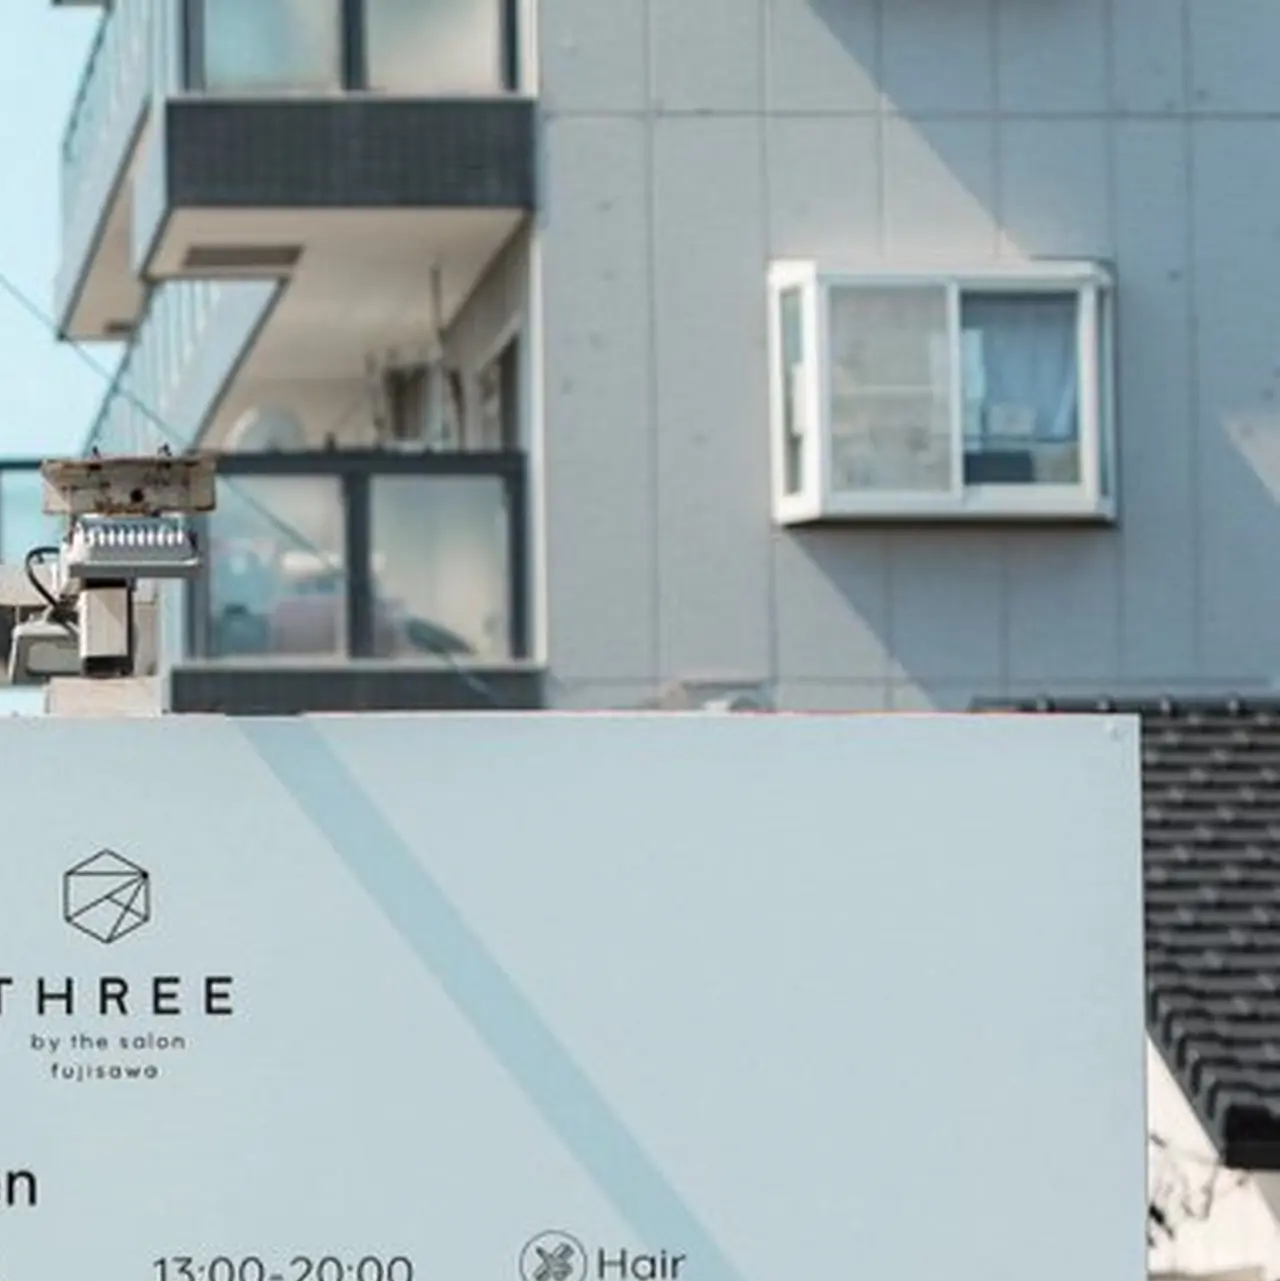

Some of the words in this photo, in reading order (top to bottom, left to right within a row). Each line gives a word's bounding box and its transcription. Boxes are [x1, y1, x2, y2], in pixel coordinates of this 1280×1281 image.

[30, 1032, 60, 1054] by
[70, 1032, 109, 1051] the
[119, 1031, 186, 1051] salon
[50, 1061, 159, 1083] fujisawa
[597, 1247, 687, 1281] Hair
